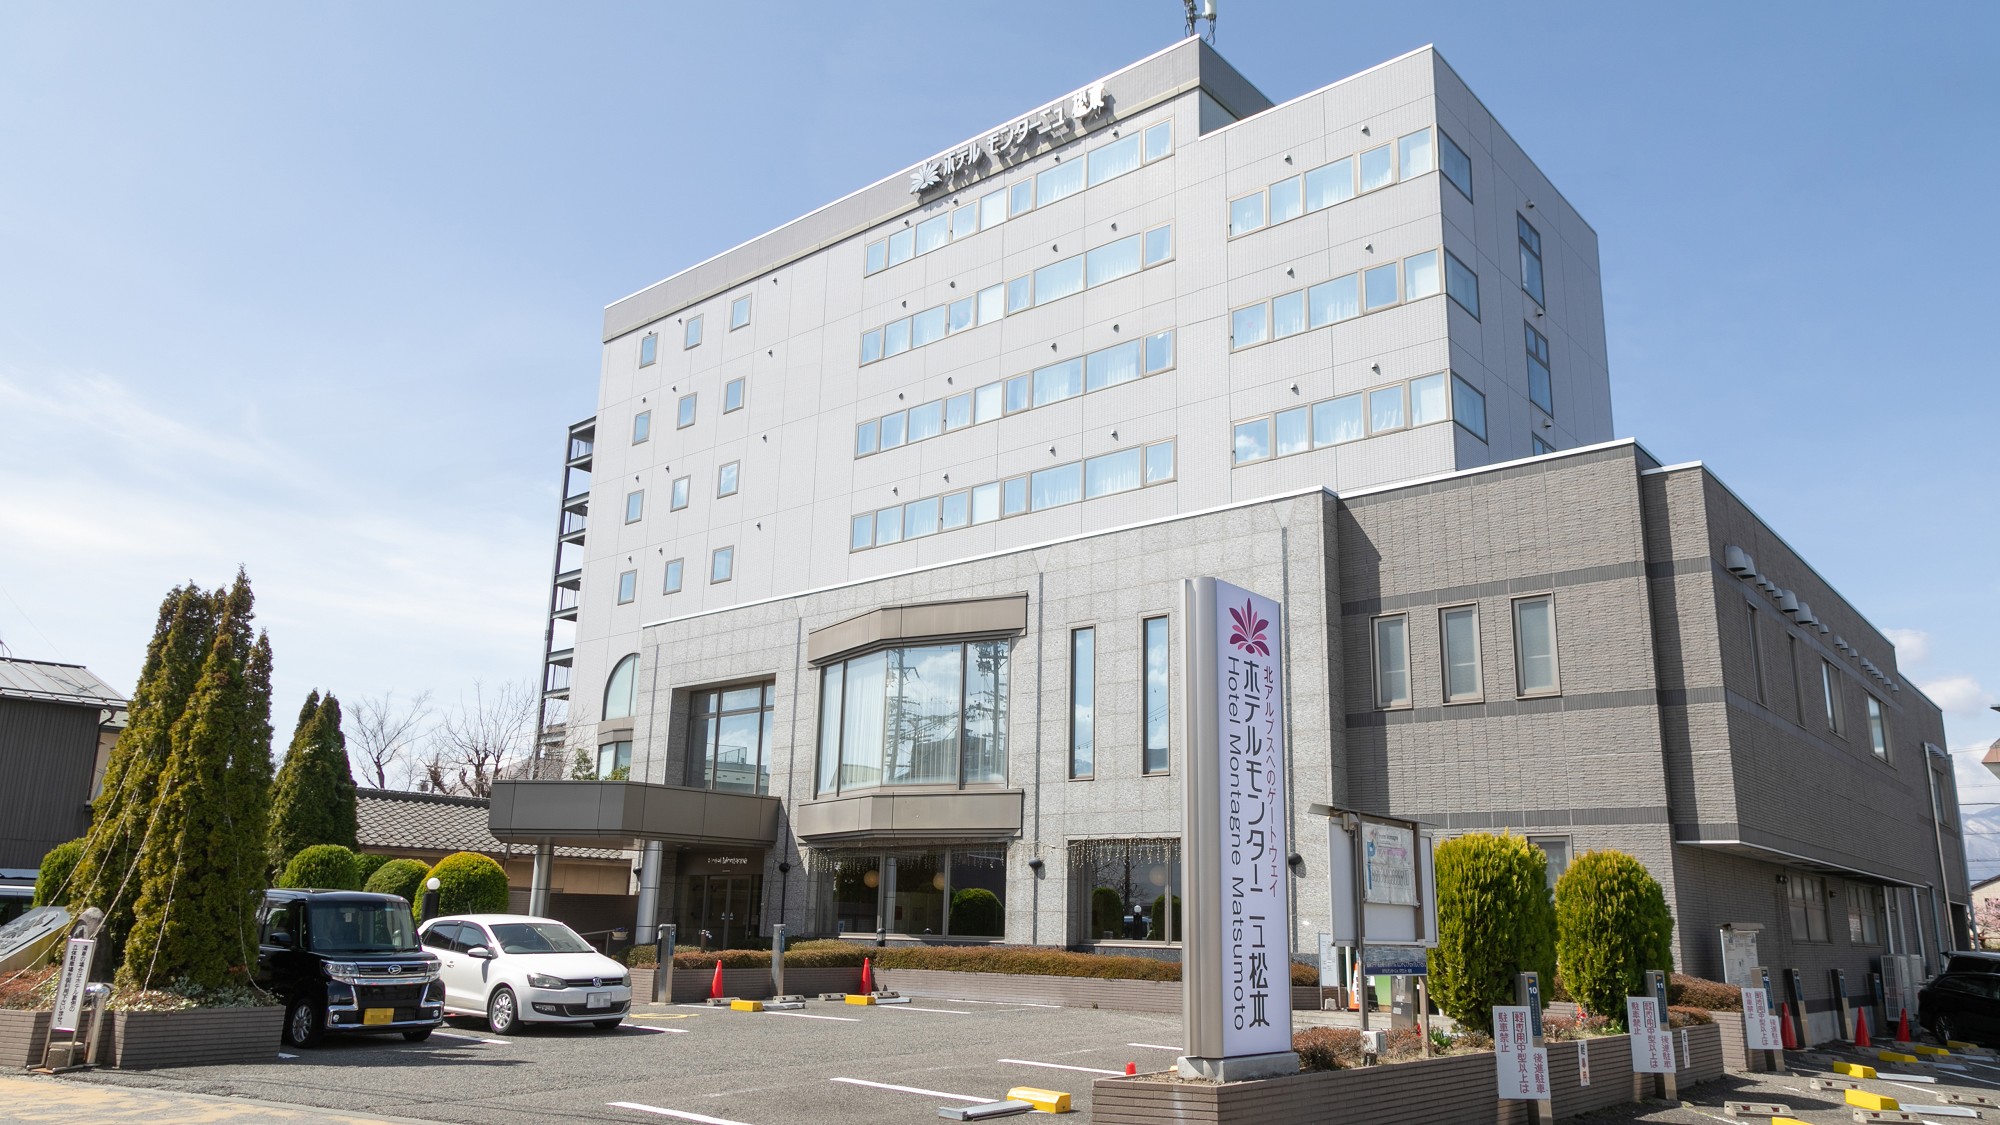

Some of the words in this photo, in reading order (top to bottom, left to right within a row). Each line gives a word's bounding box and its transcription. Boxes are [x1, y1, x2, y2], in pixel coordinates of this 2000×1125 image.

[943, 142, 981, 176] ホテル
[986, 106, 1065, 152] モンターニュ
[1227, 656, 1240, 724] Hotel
[1228, 733, 1242, 866] Montagne
[1263, 665, 1278, 898] 北アルプスへのゲートウェイ
[1243, 660, 1270, 1028] ホテルモンターニュ松本
[1231, 876, 1246, 1031] Matsumoto
[1528, 986, 1538, 994] 10
[1631, 1002, 1642, 1035] 駐車禁止
[1498, 1012, 1510, 1053] 駐車禁止
[1533, 1053, 1546, 1094] 後進駐車
